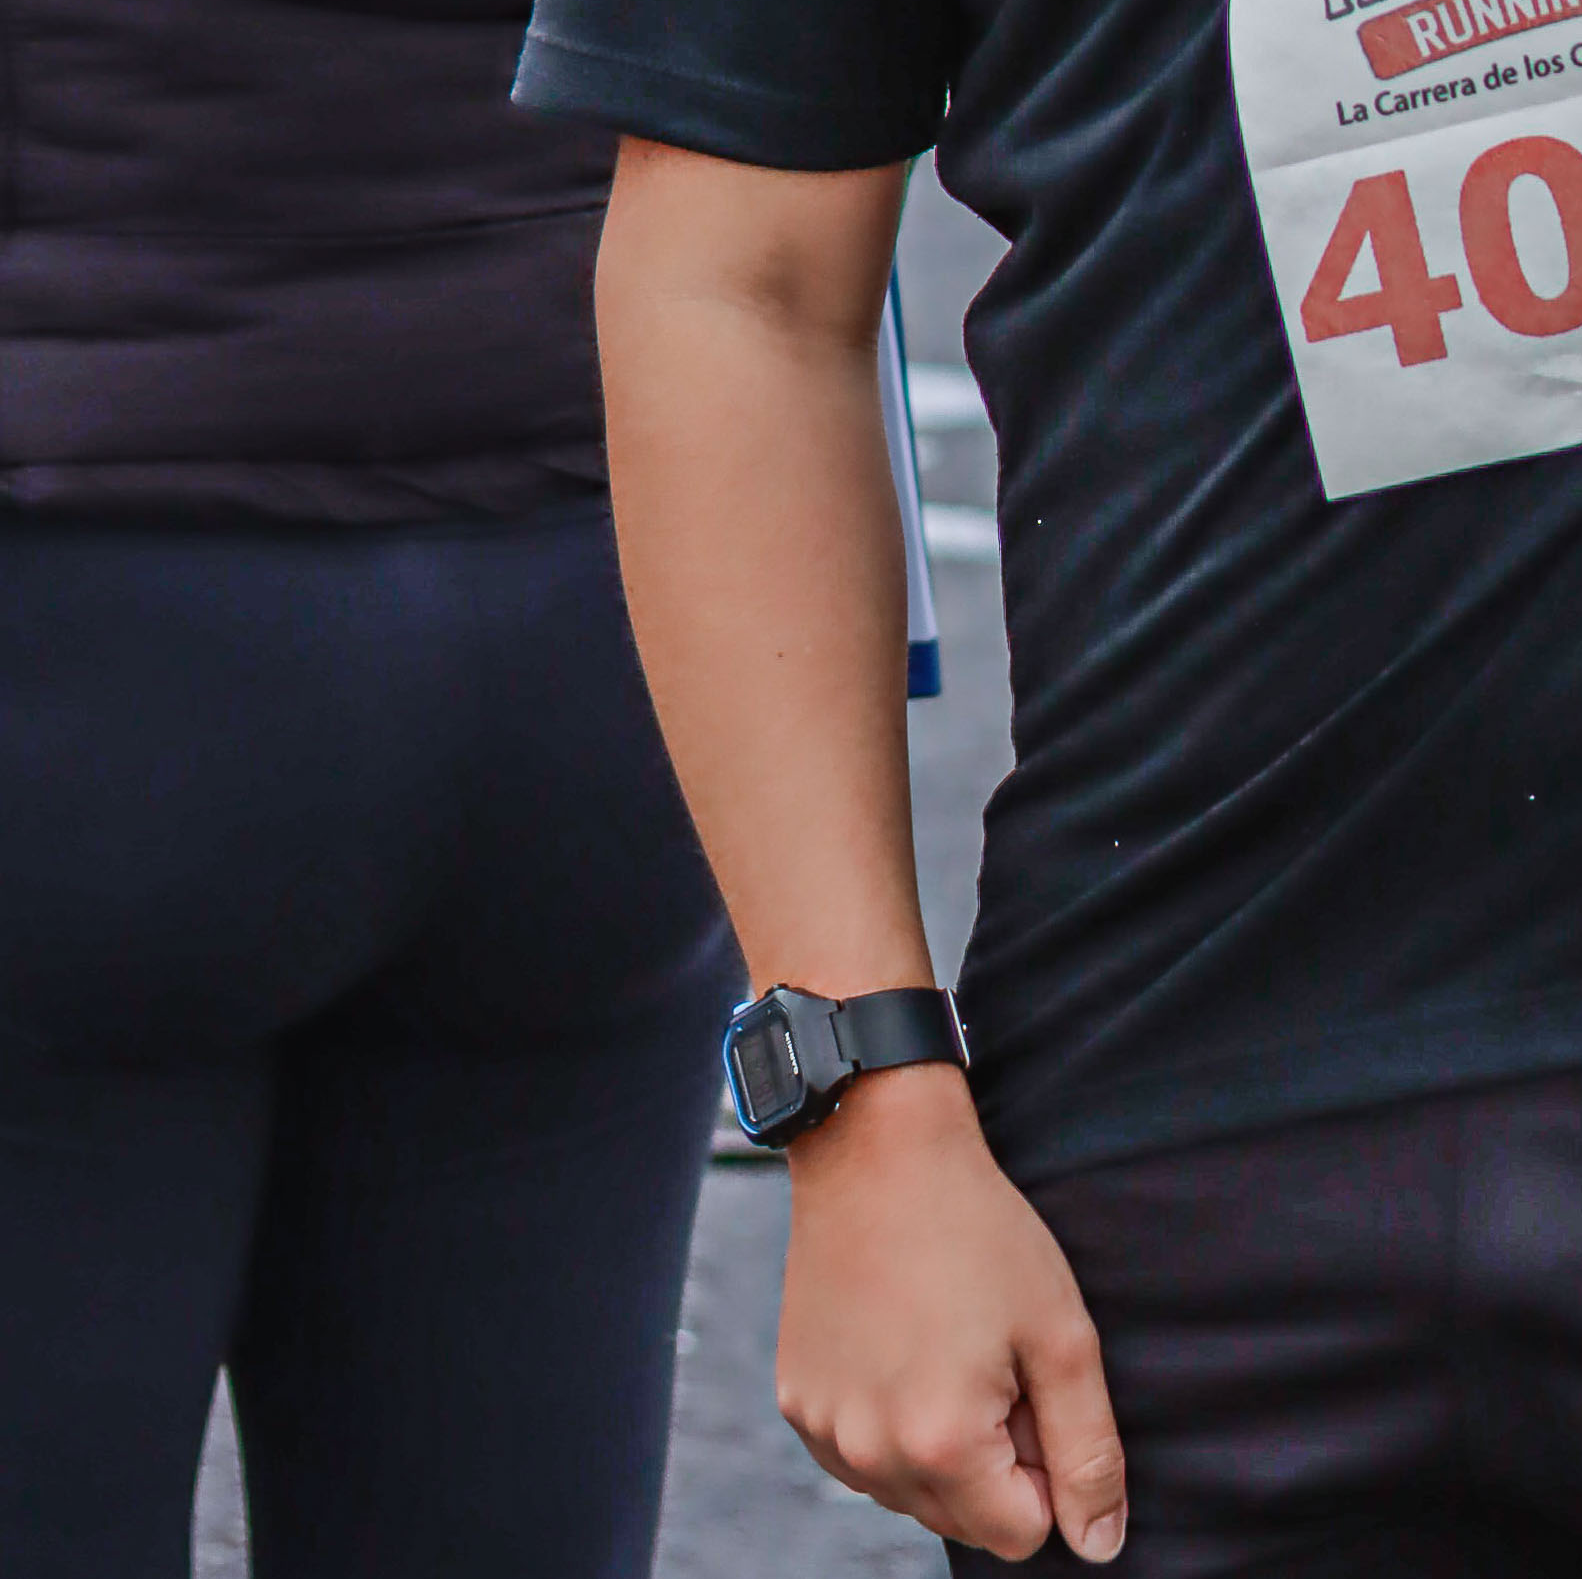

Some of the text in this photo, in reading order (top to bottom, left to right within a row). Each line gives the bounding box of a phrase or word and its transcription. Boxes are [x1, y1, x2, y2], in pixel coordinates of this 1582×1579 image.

[1336, 99, 1369, 126] La
[1374, 76, 1477, 115] Carrera
[1483, 63, 1518, 91] de
[1523, 54, 1564, 81] los
